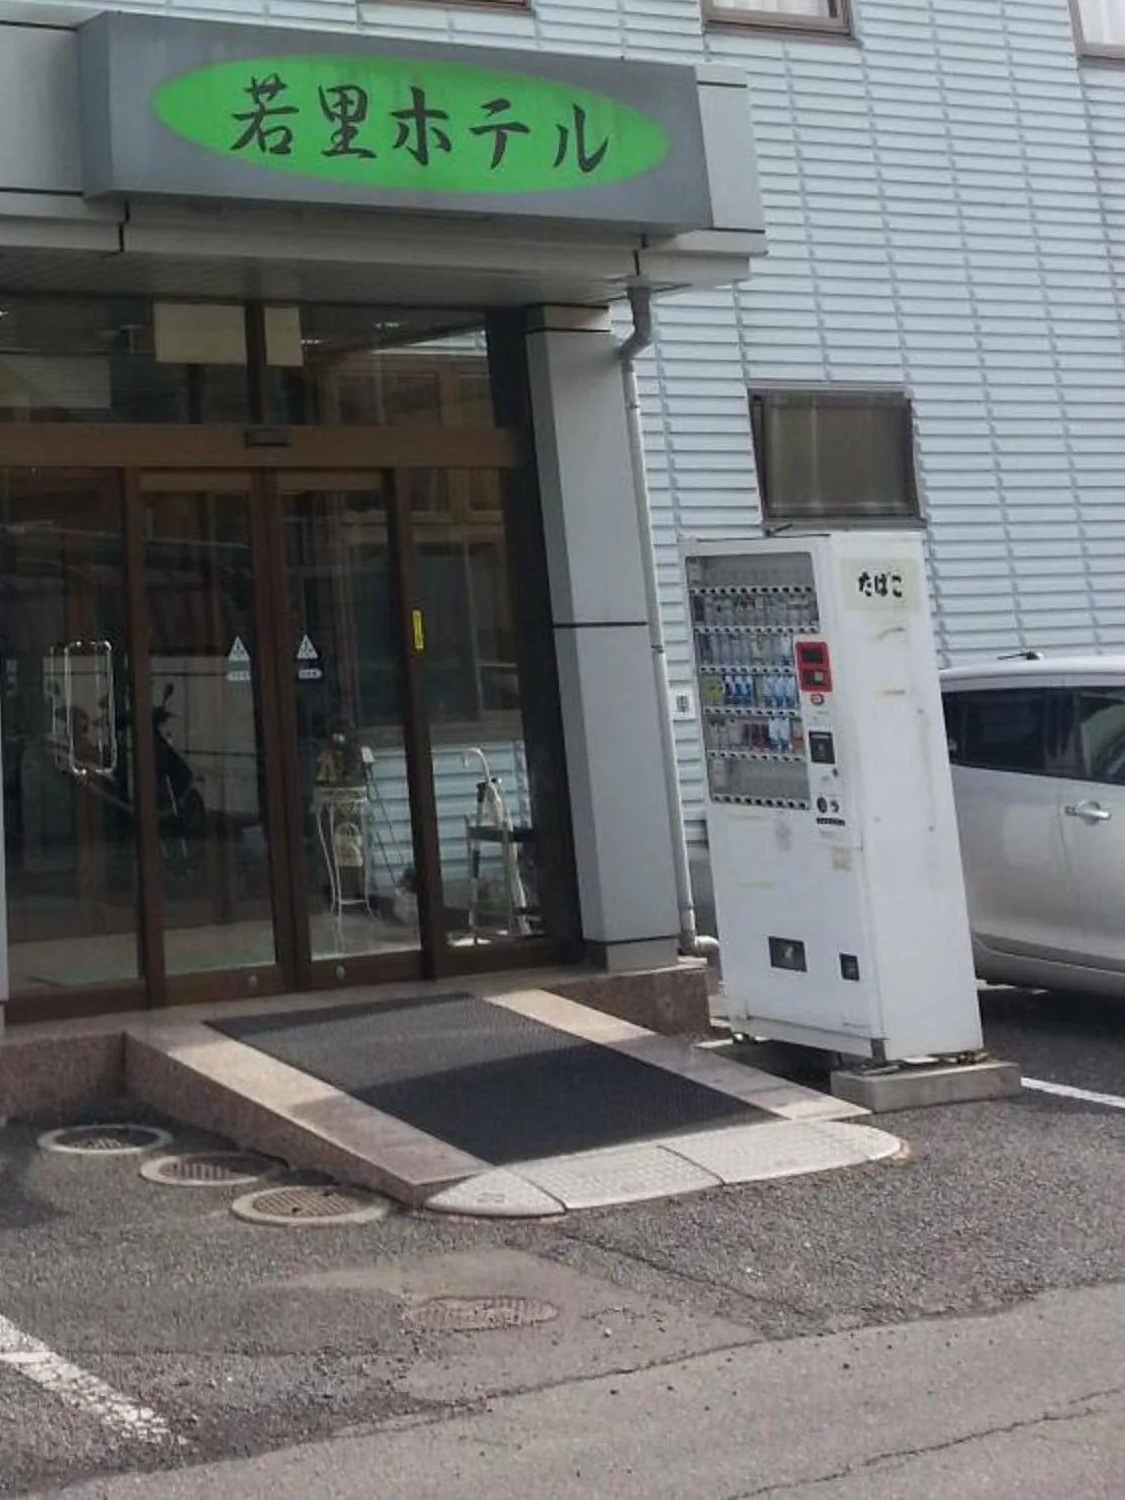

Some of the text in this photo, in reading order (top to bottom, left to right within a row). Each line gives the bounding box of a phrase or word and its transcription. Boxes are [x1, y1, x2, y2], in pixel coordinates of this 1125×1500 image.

[230, 73, 609, 174] 若里ホテル
[858, 571, 903, 598] たばこ
